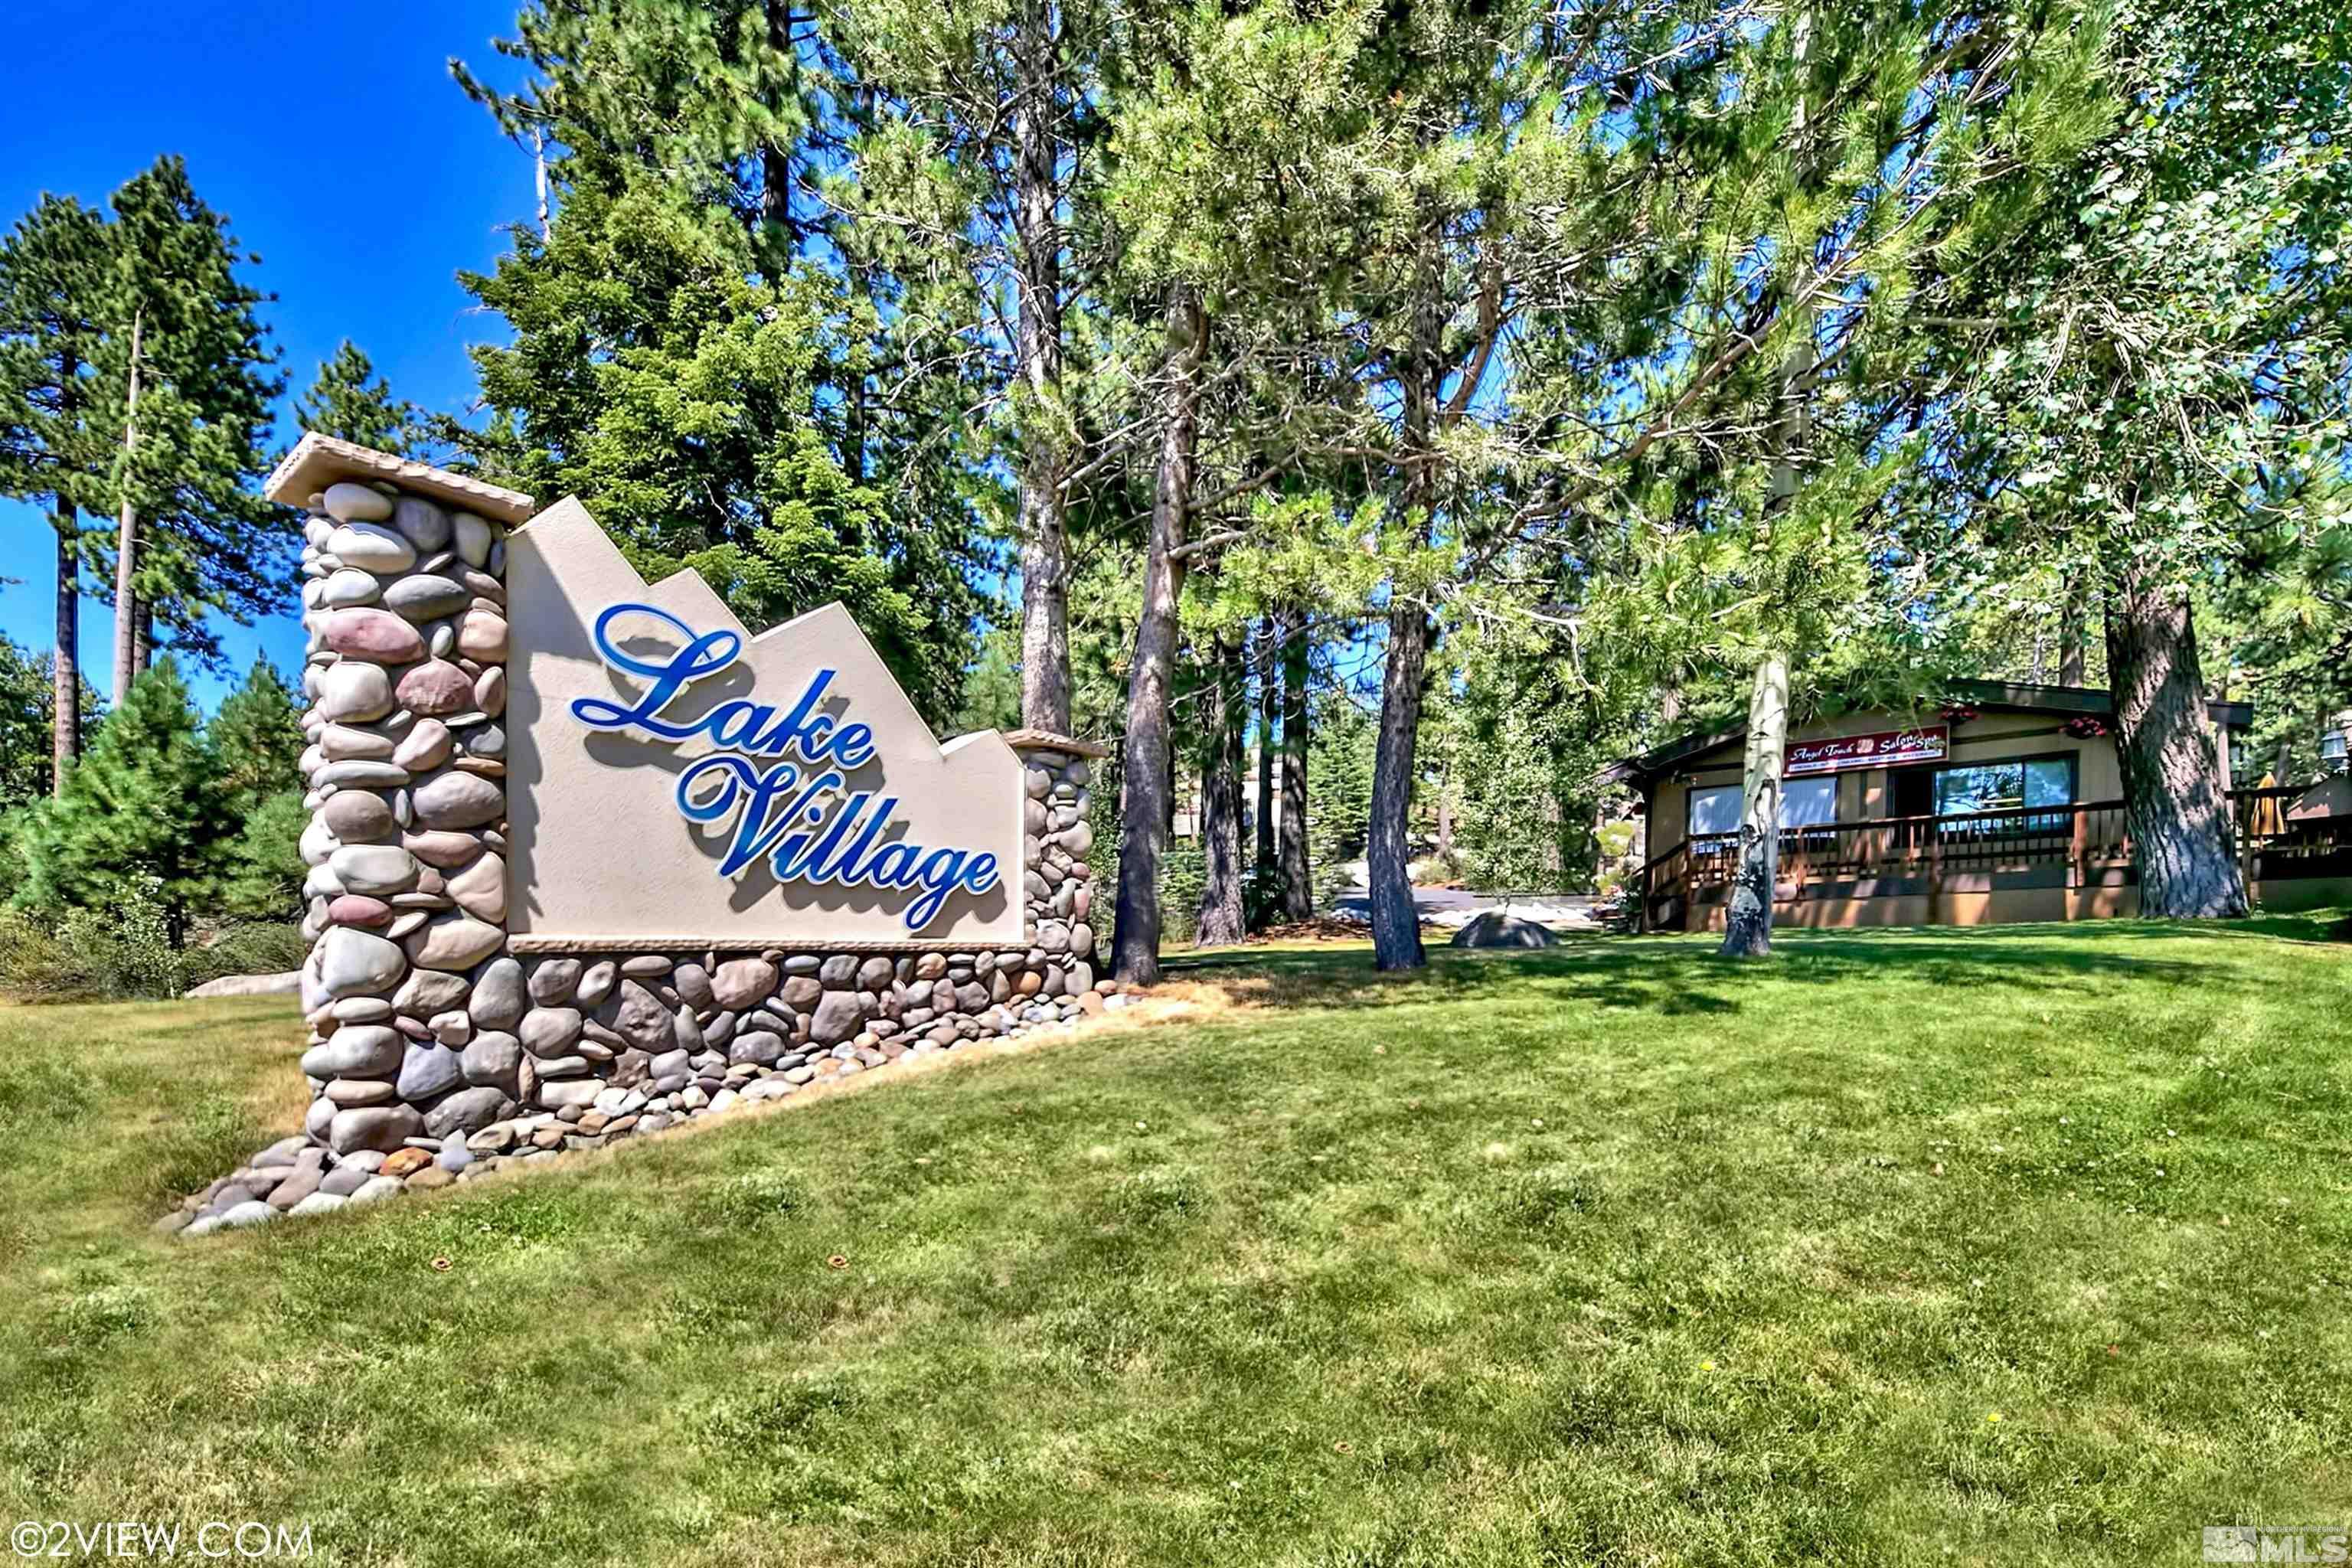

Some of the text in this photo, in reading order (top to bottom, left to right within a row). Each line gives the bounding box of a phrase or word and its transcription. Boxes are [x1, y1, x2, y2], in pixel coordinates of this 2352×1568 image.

[567, 602, 876, 768] Lake
[1790, 746, 1824, 760] Angel
[1880, 733, 1914, 753] Salon
[675, 753, 999, 932] Village
